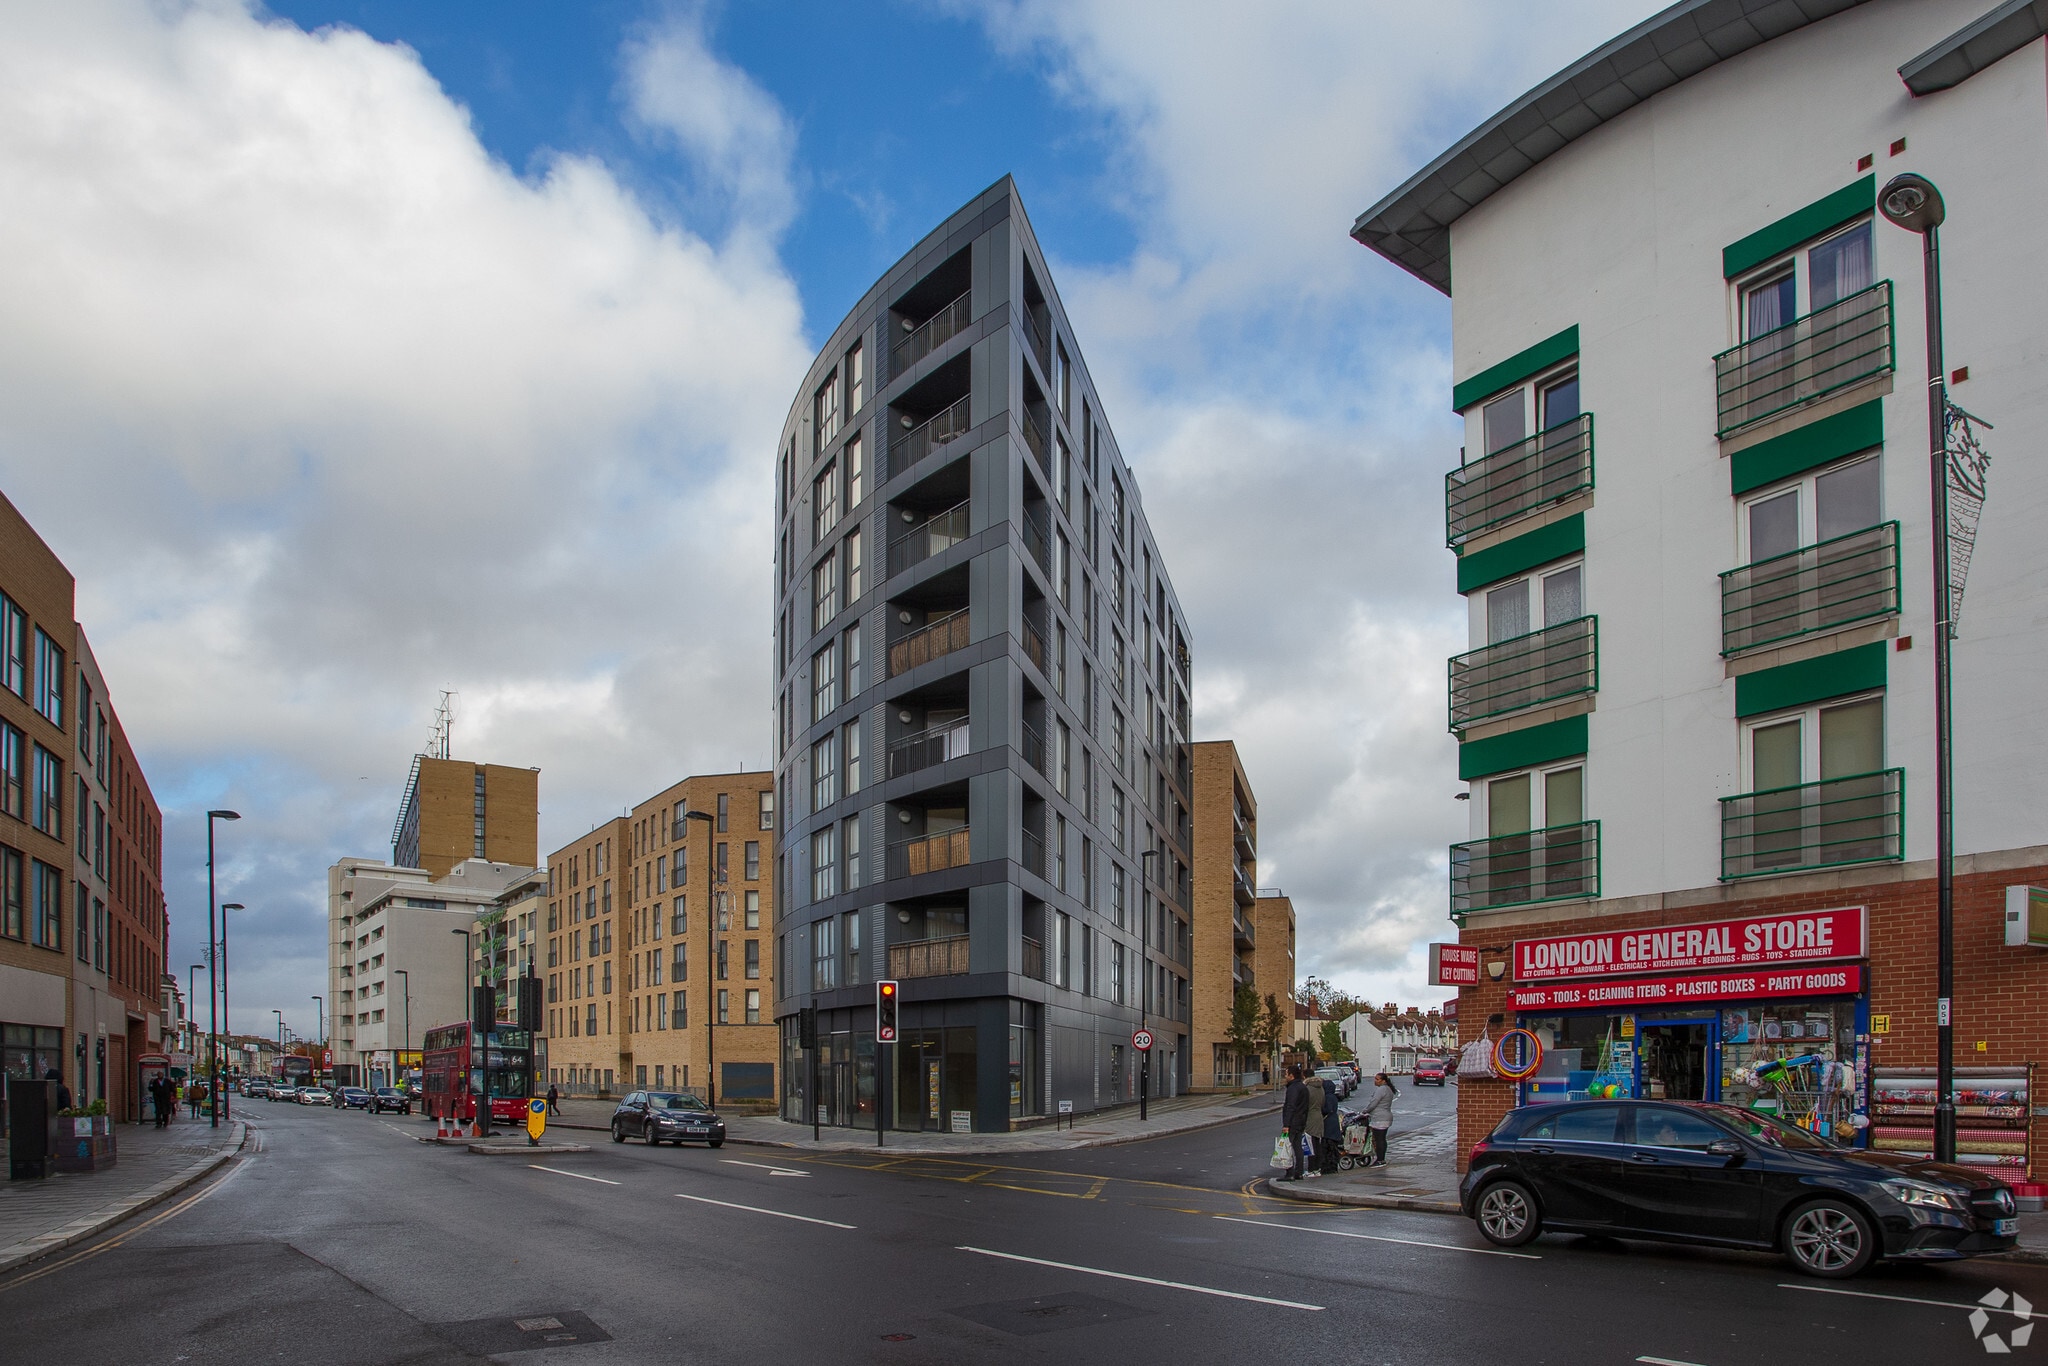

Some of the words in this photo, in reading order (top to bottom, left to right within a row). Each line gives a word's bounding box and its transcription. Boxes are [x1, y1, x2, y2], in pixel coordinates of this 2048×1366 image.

[1523, 937, 1613, 970] LONDON
[1621, 926, 1736, 962] GENERAL
[1744, 916, 1834, 952] STORE
[1441, 948, 1460, 962] HOUSE
[1460, 950, 1476, 963] WARE
[1523, 970, 1533, 978] KEY
[1533, 968, 1556, 977] CUTTING
[1560, 967, 1569, 975] DIY
[1573, 964, 1605, 974] HARDWARE
[1610, 961, 1648, 971] ELECTRICALS
[1652, 957, 1697, 968] KITCHENWARE
[1702, 954, 1735, 965] BEDDINGS
[1741, 952, 1760, 961] RUGS
[1766, 950, 1783, 960] TOYS
[1789, 947, 1833, 958] STATIONERY
[1441, 967, 1453, 980] KEY
[1452, 967, 1476, 981] CUTTING
[1516, 991, 1546, 1005] PAINTS
[1553, 989, 1580, 1004] TOOLS
[1588, 986, 1634, 1001] CLEANING
[1636, 983, 1666, 999] ITEMS
[1675, 979, 1718, 996] PLASTIC
[1720, 977, 1756, 994] BOXES
[1768, 975, 1803, 991] PARTY
[1805, 972, 1846, 989] GOODS
[1135, 1035, 1150, 1045] 20
[511, 1055, 523, 1064] 64
